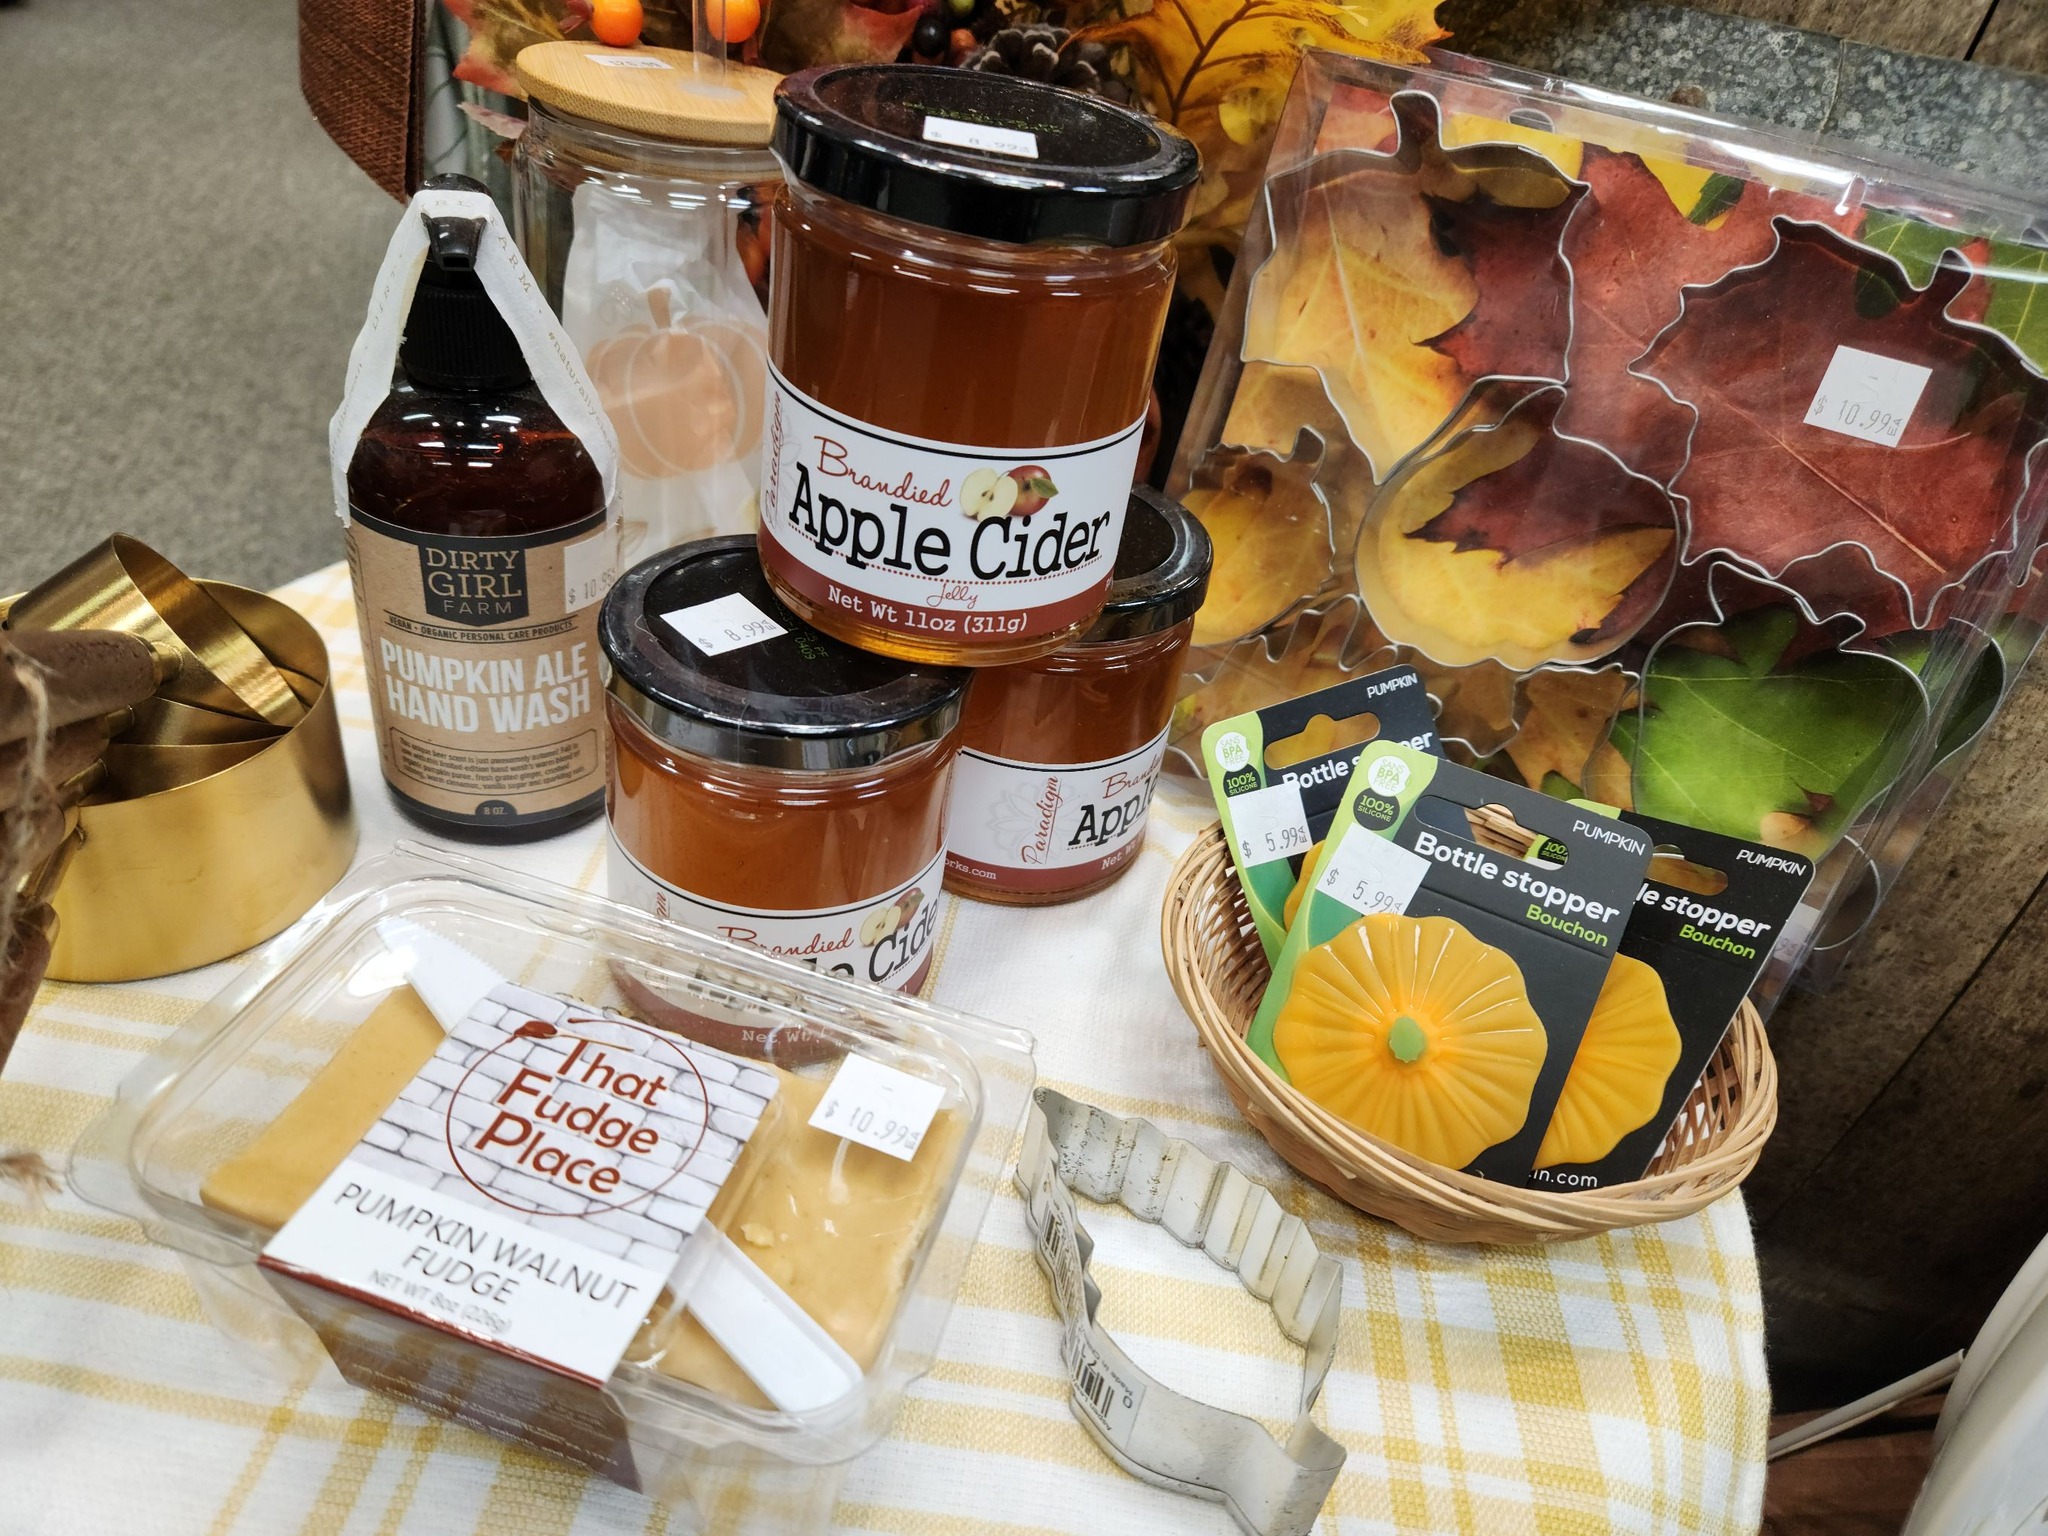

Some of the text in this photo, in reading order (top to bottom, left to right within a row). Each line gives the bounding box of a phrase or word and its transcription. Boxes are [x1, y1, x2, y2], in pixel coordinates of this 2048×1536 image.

[1814, 395, 1828, 415] $
[1838, 400, 1892, 434] 10.99
[814, 436, 953, 508] Brandied
[789, 462, 1111, 581] Apple Cider
[425, 547, 521, 571] DIRTY
[428, 571, 523, 599] GIRL
[925, 582, 979, 610] Jelly
[443, 600, 512, 616] FARM
[828, 584, 1028, 635] Net Wt 11oz (311g)
[388, 615, 573, 641] VEGAN ORGANIC PERSONAL CARE PRODUCTS
[698, 636, 714, 650] $
[724, 621, 766, 641] 8.99
[380, 637, 588, 694] PUMPKIN ALE
[1366, 672, 1419, 699] PUMPKIN
[385, 677, 590, 733] HAND WASH
[1222, 744, 1244, 759] BPA
[1226, 771, 1256, 790] 100%
[1229, 782, 1258, 796] SILICONE
[1282, 759, 1350, 789] Bottle
[1376, 766, 1400, 785] BPA
[483, 807, 491, 815] 8
[1020, 775, 1064, 865] Paradigm
[1357, 805, 1392, 823] SILICONE
[1360, 795, 1395, 816] 100%
[1242, 840, 1252, 859] $
[1264, 827, 1299, 853] 5.99
[1572, 819, 1647, 857] PUMPKIN
[1101, 853, 1123, 871] Net
[1541, 850, 1568, 861] SILICON
[1735, 849, 1807, 877] PUMPKIN
[1326, 868, 1340, 886] $
[1352, 879, 1394, 914] 5.99
[1414, 831, 1499, 880] Bottle
[1502, 869, 1621, 924] stopper
[1525, 904, 1610, 947] Bouchon
[1661, 894, 1772, 939] stopper
[1678, 924, 1757, 960] Bouchon
[556, 1038, 668, 1107] That
[495, 1068, 659, 1154] Fudge
[824, 1099, 840, 1119] $
[849, 1106, 909, 1146] 10.99
[474, 1111, 622, 1194] Place
[333, 1182, 639, 1310] PUMPKIN WALNUT
[368, 1268, 399, 1291] NET
[402, 1280, 430, 1302] WT
[402, 1245, 520, 1305] FUDGE
